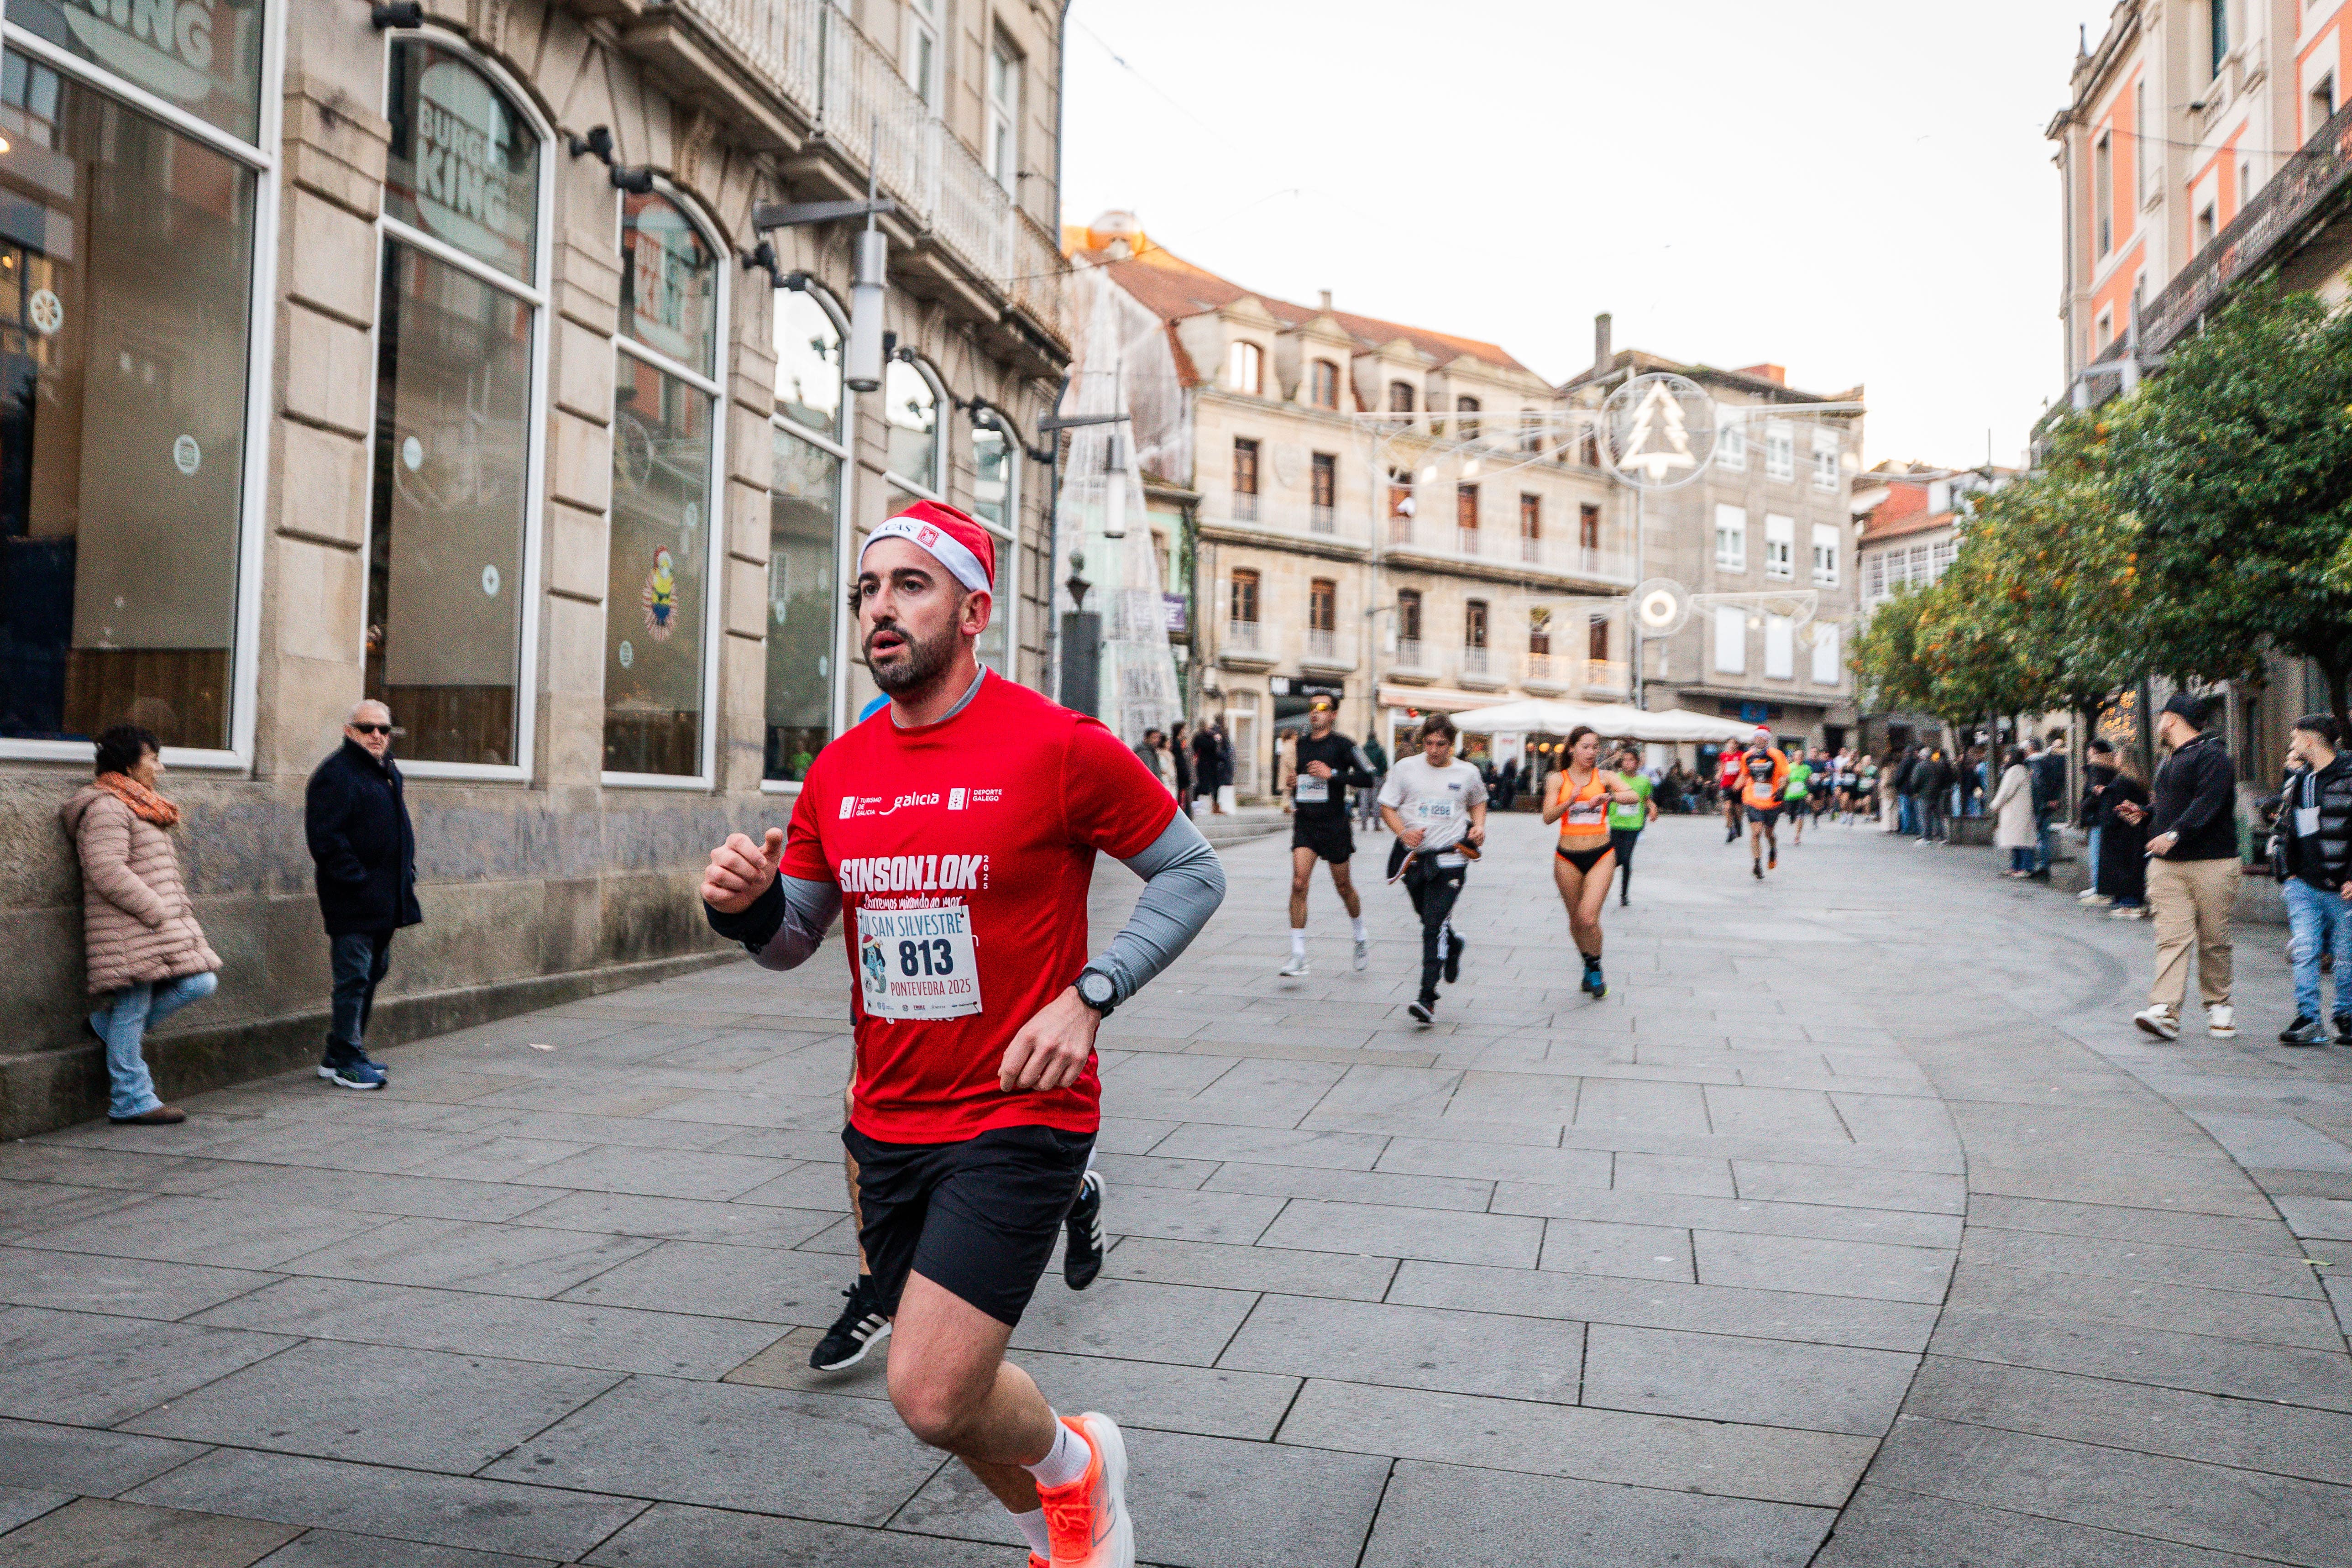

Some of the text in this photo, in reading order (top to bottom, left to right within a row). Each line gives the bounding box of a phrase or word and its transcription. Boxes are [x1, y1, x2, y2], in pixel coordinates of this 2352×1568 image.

[417, 138, 508, 231] KING
[880, 791, 940, 815] galicia
[899, 892, 929, 910] mirando
[930, 897, 940, 908] ao
[943, 895, 963, 907] mar
[872, 916, 895, 937] SAN
[897, 912, 963, 936] SILVESTRE
[899, 939, 953, 976] 813
[891, 981, 946, 996] PONTEVEDRA
[947, 978, 971, 994] 2025
